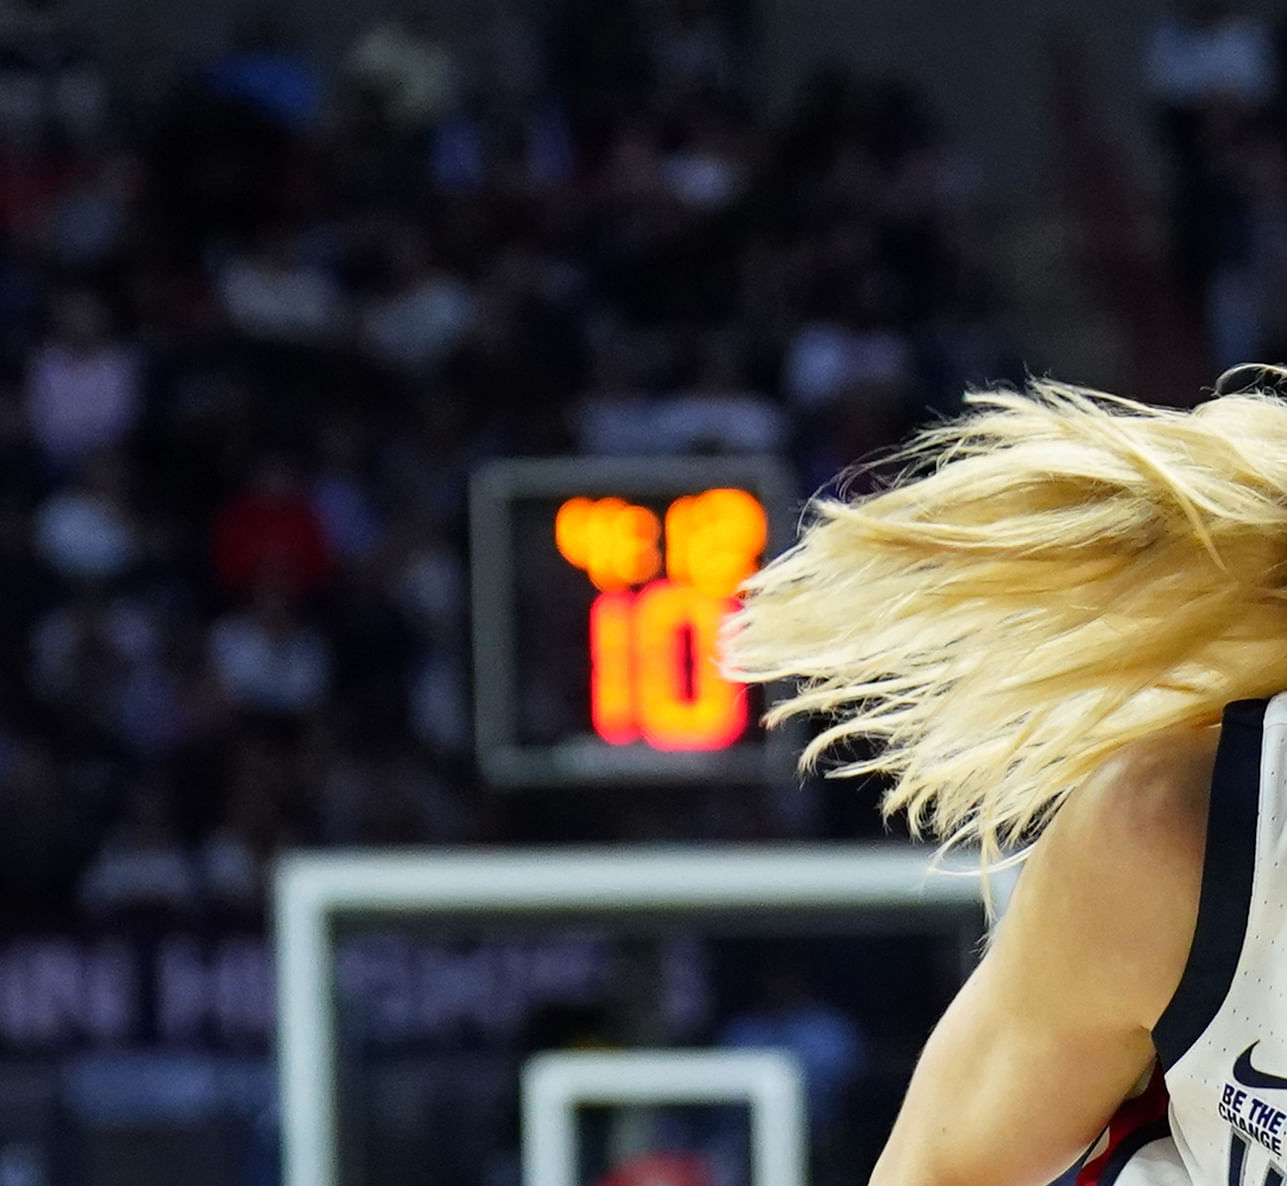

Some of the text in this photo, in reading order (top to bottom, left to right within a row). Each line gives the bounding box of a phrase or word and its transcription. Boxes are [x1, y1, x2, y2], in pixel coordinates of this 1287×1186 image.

[589, 578, 748, 752] 10
[1218, 1102, 1282, 1157] CHANGE
[1222, 1083, 1287, 1135] BE THE
